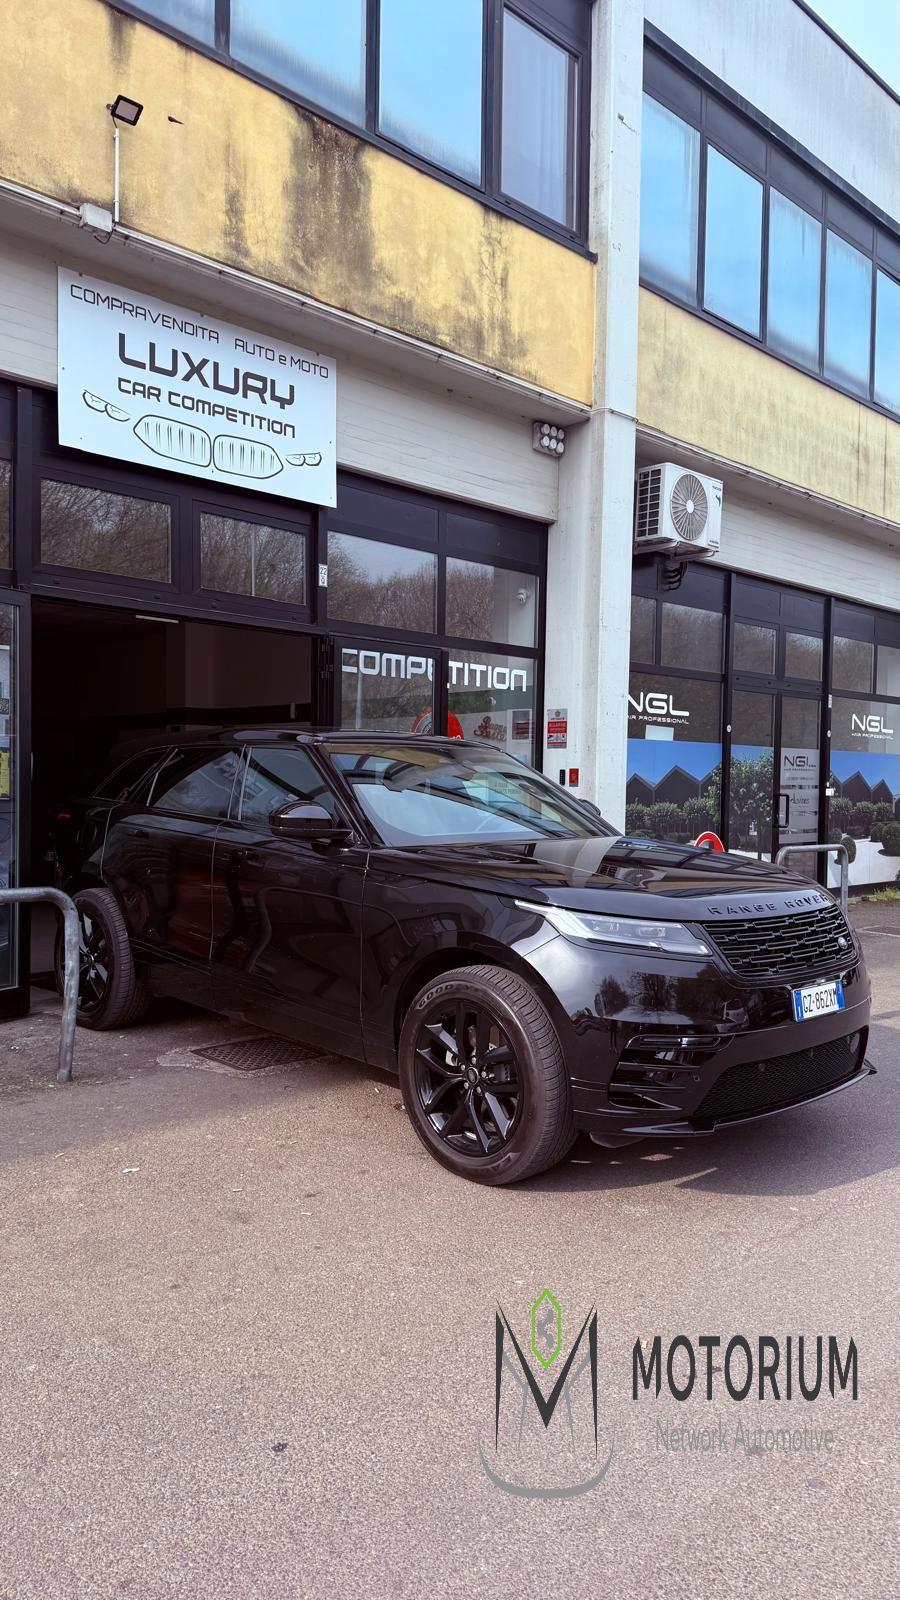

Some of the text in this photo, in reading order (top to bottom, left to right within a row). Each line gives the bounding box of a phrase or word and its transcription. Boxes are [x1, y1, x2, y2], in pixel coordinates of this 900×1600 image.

[70, 284, 219, 344] COMPRAVENDITA
[235, 338, 275, 362] AUTO
[290, 356, 329, 379] MOTO
[118, 332, 295, 410] LUXURY
[117, 376, 295, 439] CAR COMPETITION
[851, 713, 894, 734] NGL
[707, 894, 829, 915] RANGE ROVER
